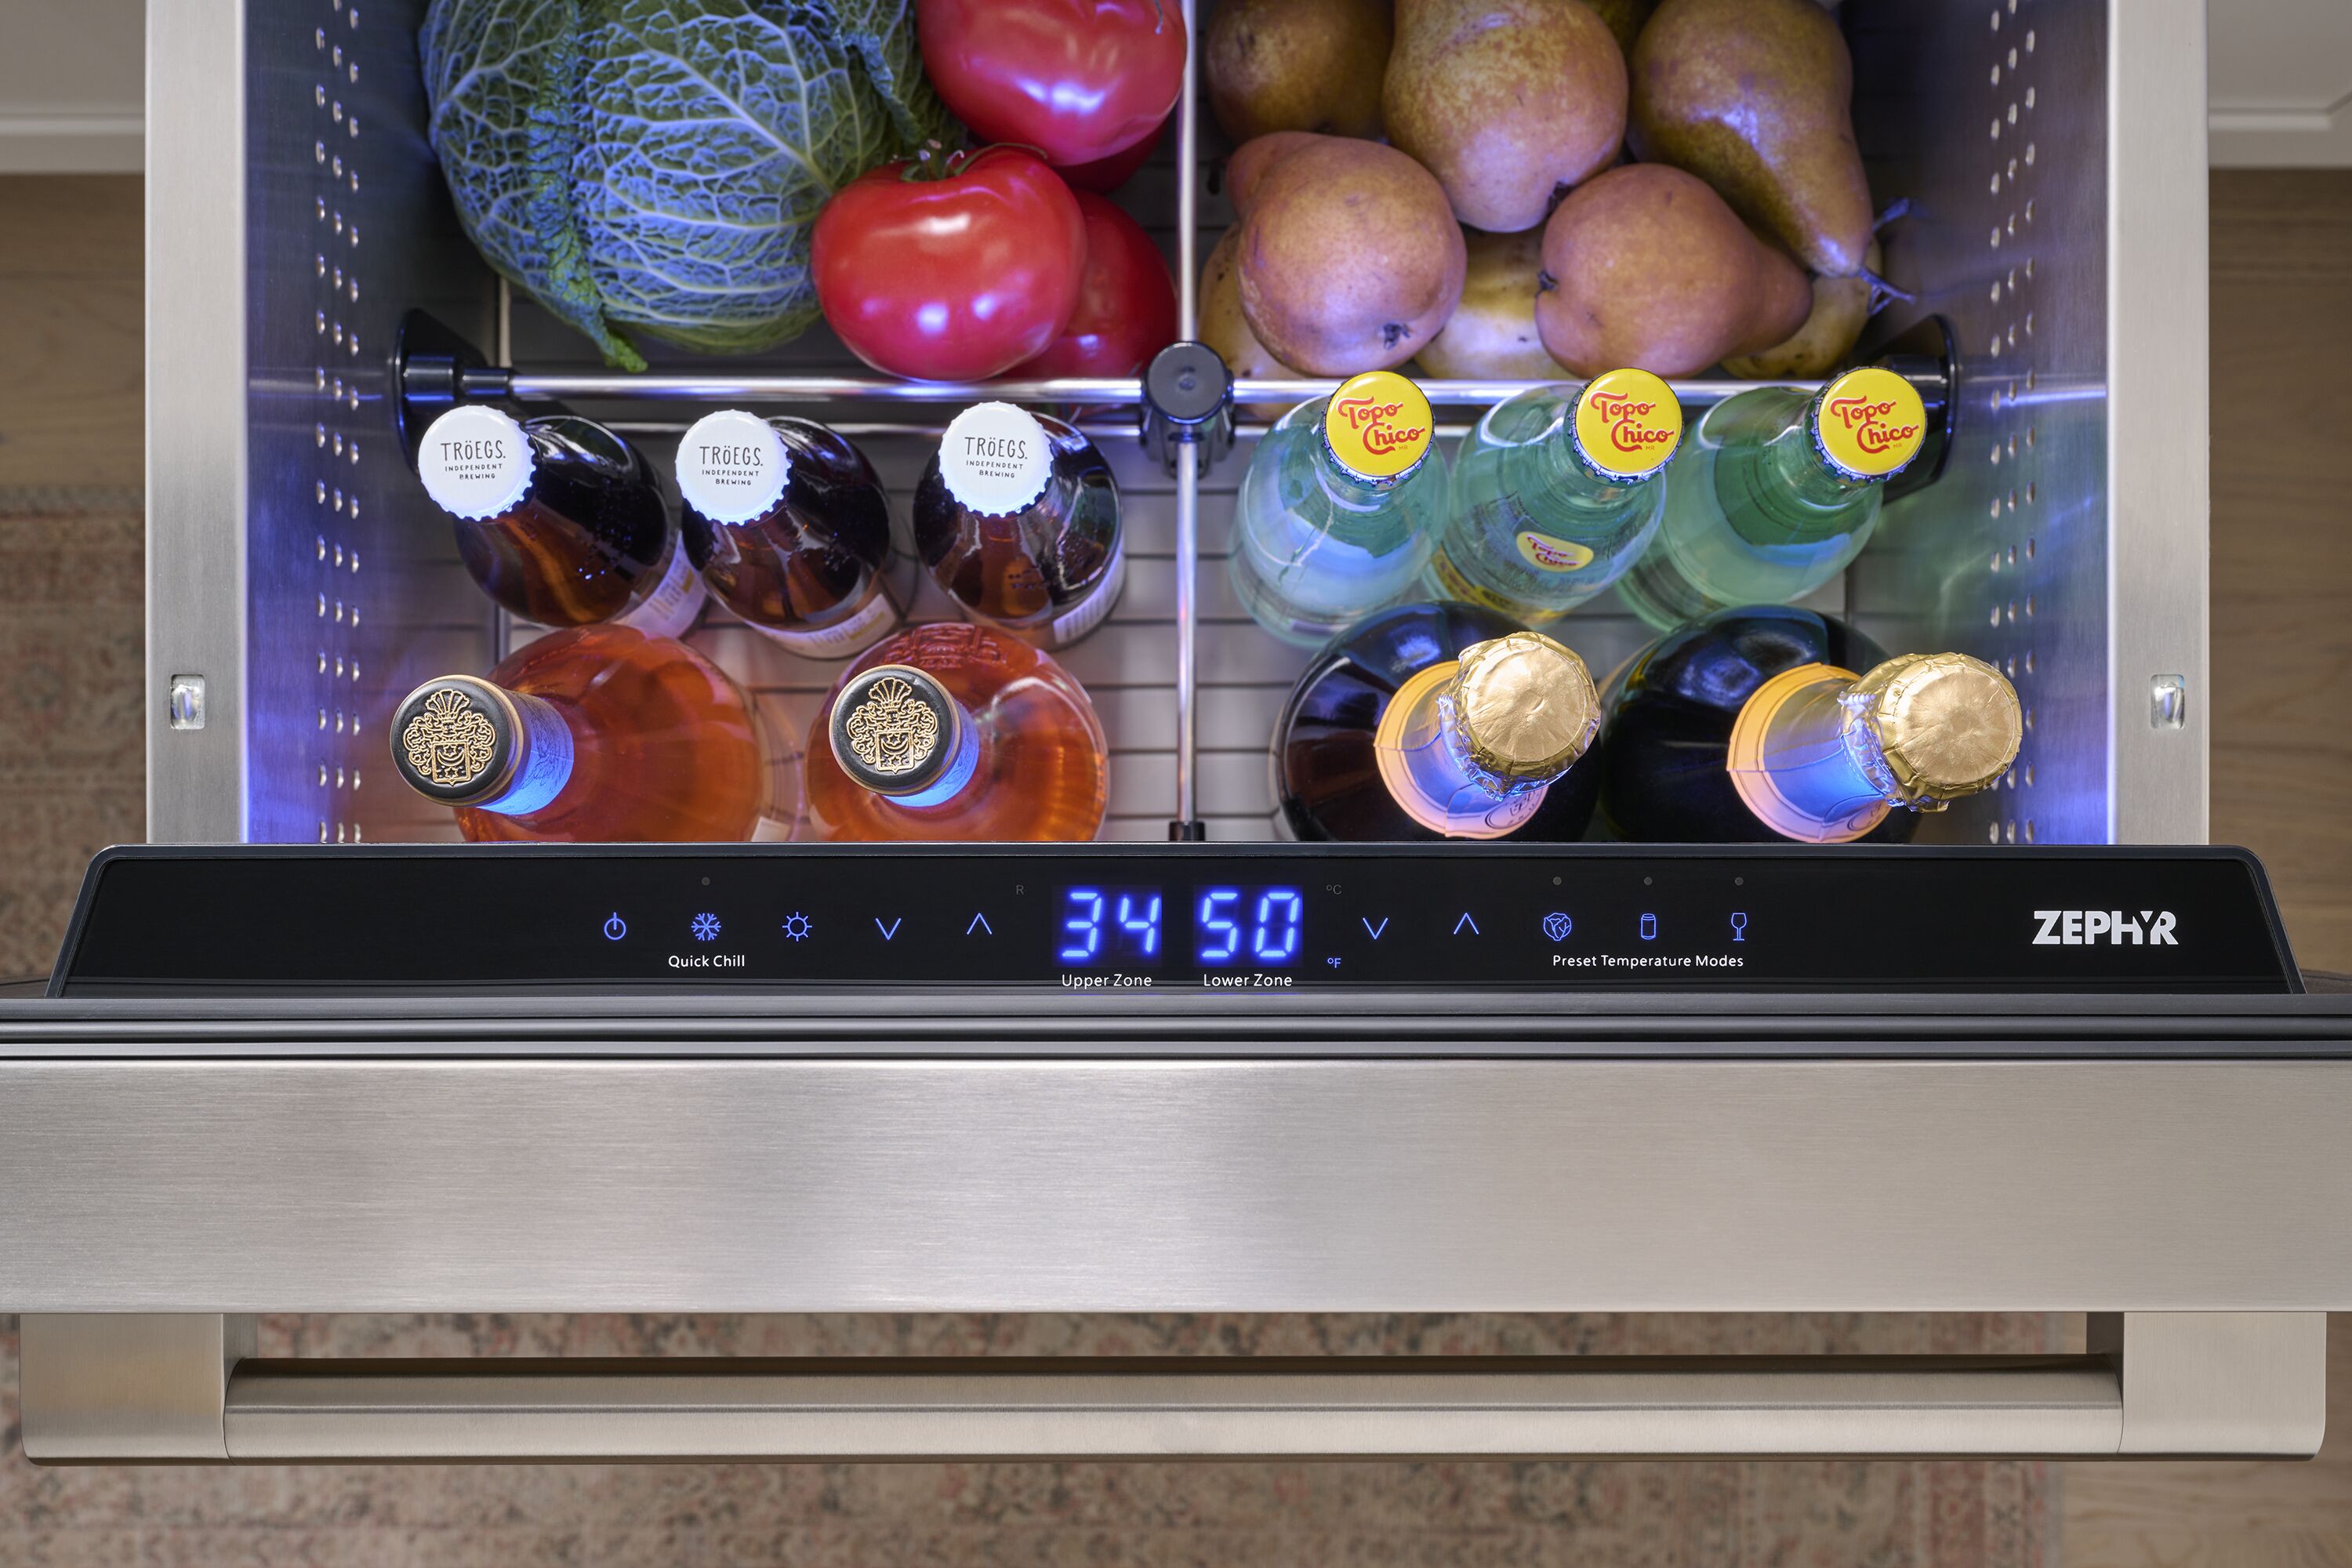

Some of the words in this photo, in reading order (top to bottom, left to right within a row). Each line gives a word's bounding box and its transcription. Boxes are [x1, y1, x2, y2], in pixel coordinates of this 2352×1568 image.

[1338, 396, 1403, 430] Topo
[1588, 393, 1656, 423] Topo
[1830, 395, 1896, 430] Topo
[1363, 422, 1425, 456] Chico
[1611, 419, 1675, 452] Chico
[1857, 421, 1919, 454] Chico
[445, 463, 503, 472] INDEPENDENT
[966, 459, 1023, 470] INDEPENDENT
[979, 470, 1015, 479] BREWING
[1016, 884, 1024, 895] R
[1062, 892, 1160, 958] 34
[1201, 892, 1300, 958] 50
[2032, 910, 2179, 945] ZEPHYR
[668, 955, 709, 968] Quick
[713, 955, 745, 967] Chill
[1553, 955, 1597, 967] Preset
[1601, 955, 1692, 969] Temperature
[1695, 955, 1744, 967] Modes
[1062, 974, 1109, 989] Upper
[1113, 974, 1152, 987] Zone
[1203, 974, 1250, 987] Lower
[1253, 974, 1293, 987] Zone
